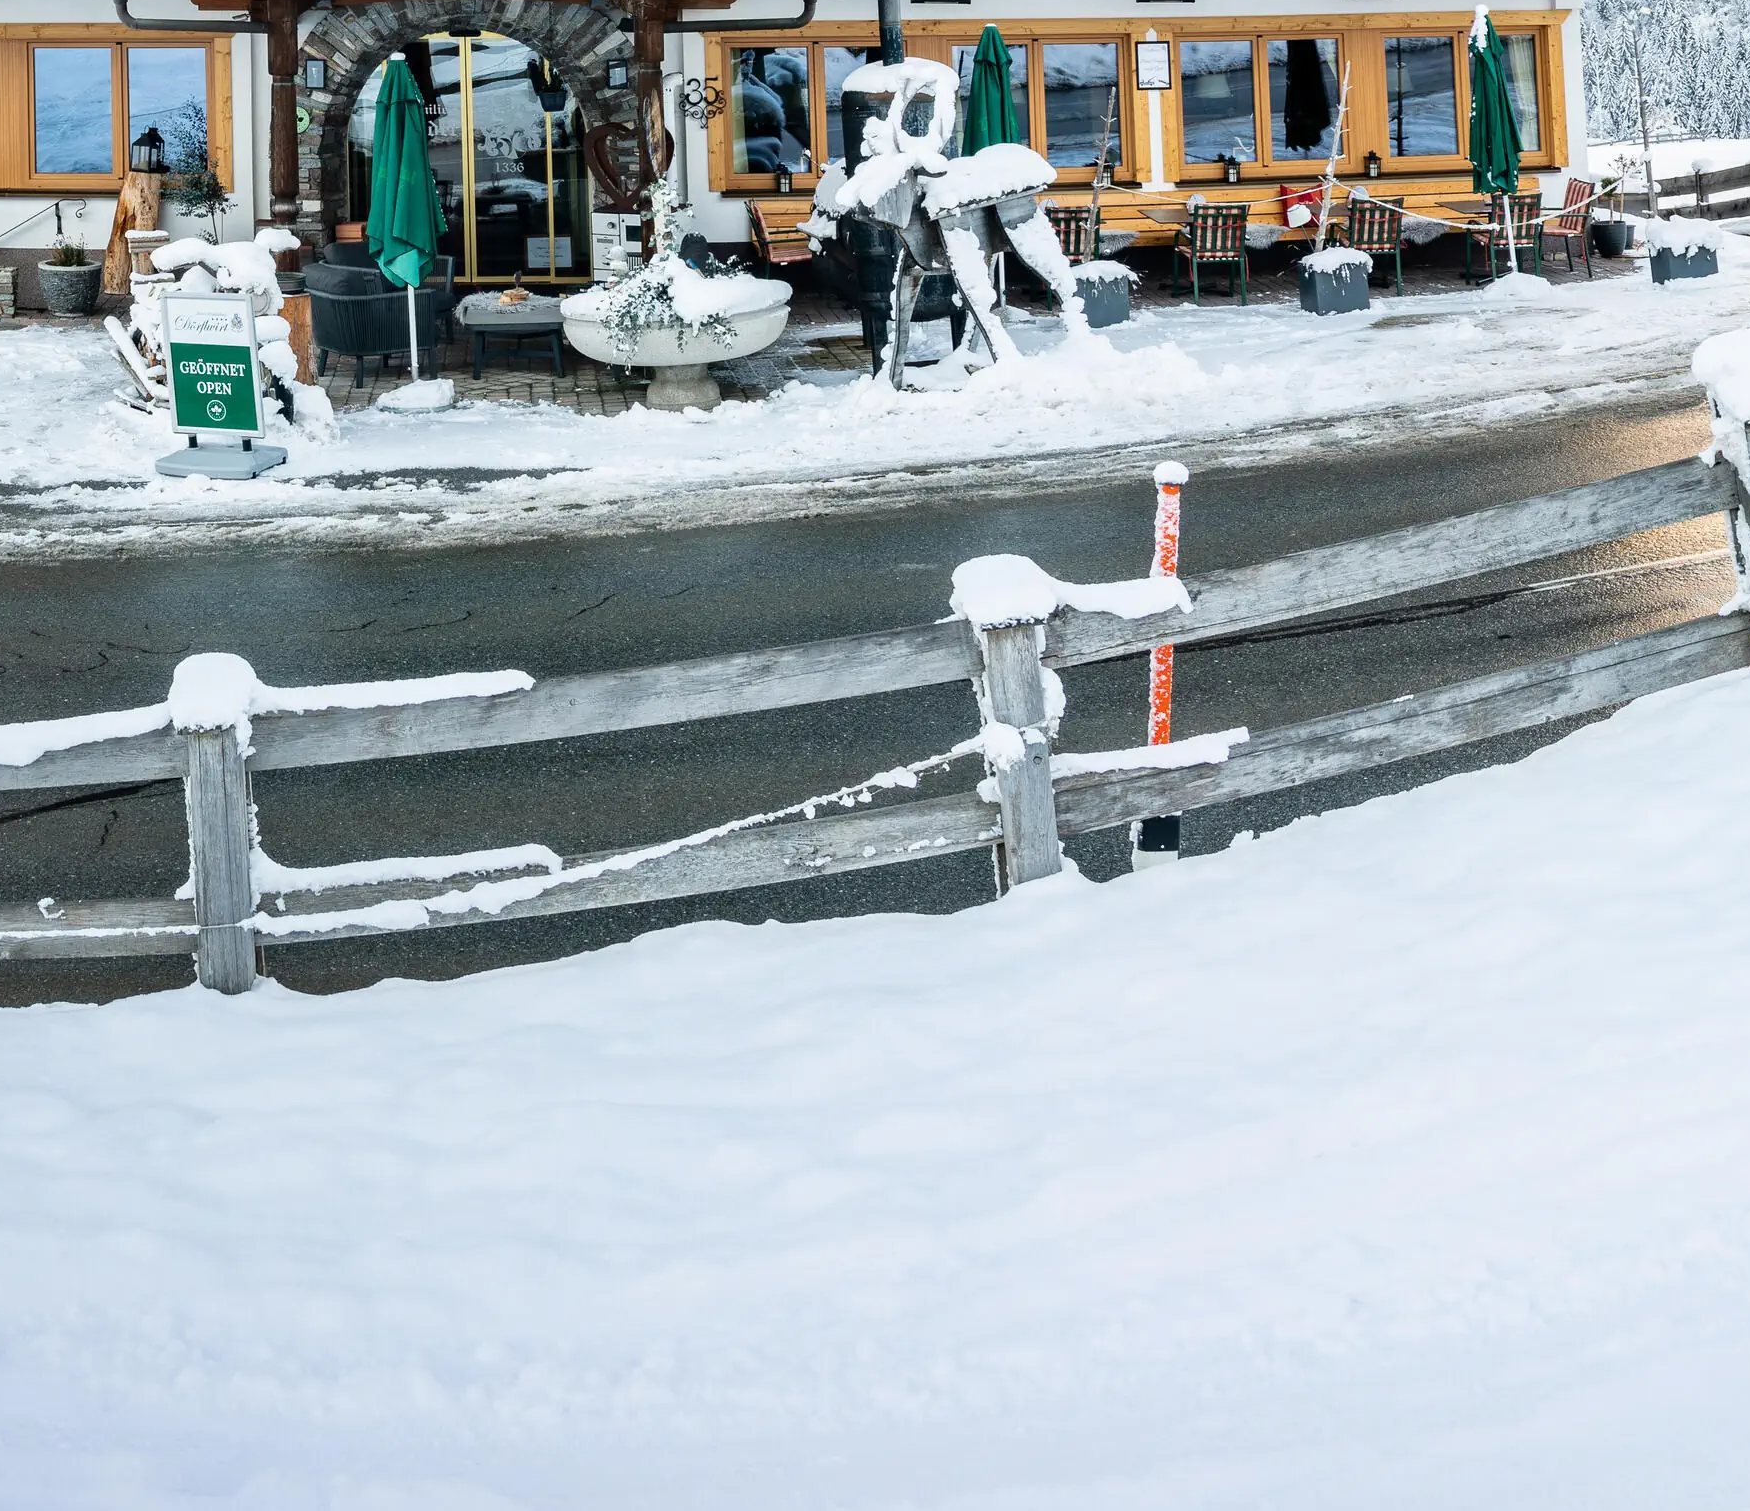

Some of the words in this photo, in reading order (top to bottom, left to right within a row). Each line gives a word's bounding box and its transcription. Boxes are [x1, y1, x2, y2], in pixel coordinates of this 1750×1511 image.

[495, 162, 525, 173] 1336
[174, 313, 229, 335] Dörflwirt
[179, 358, 246, 377] GEÖFFNET
[196, 381, 232, 396] OPEN
